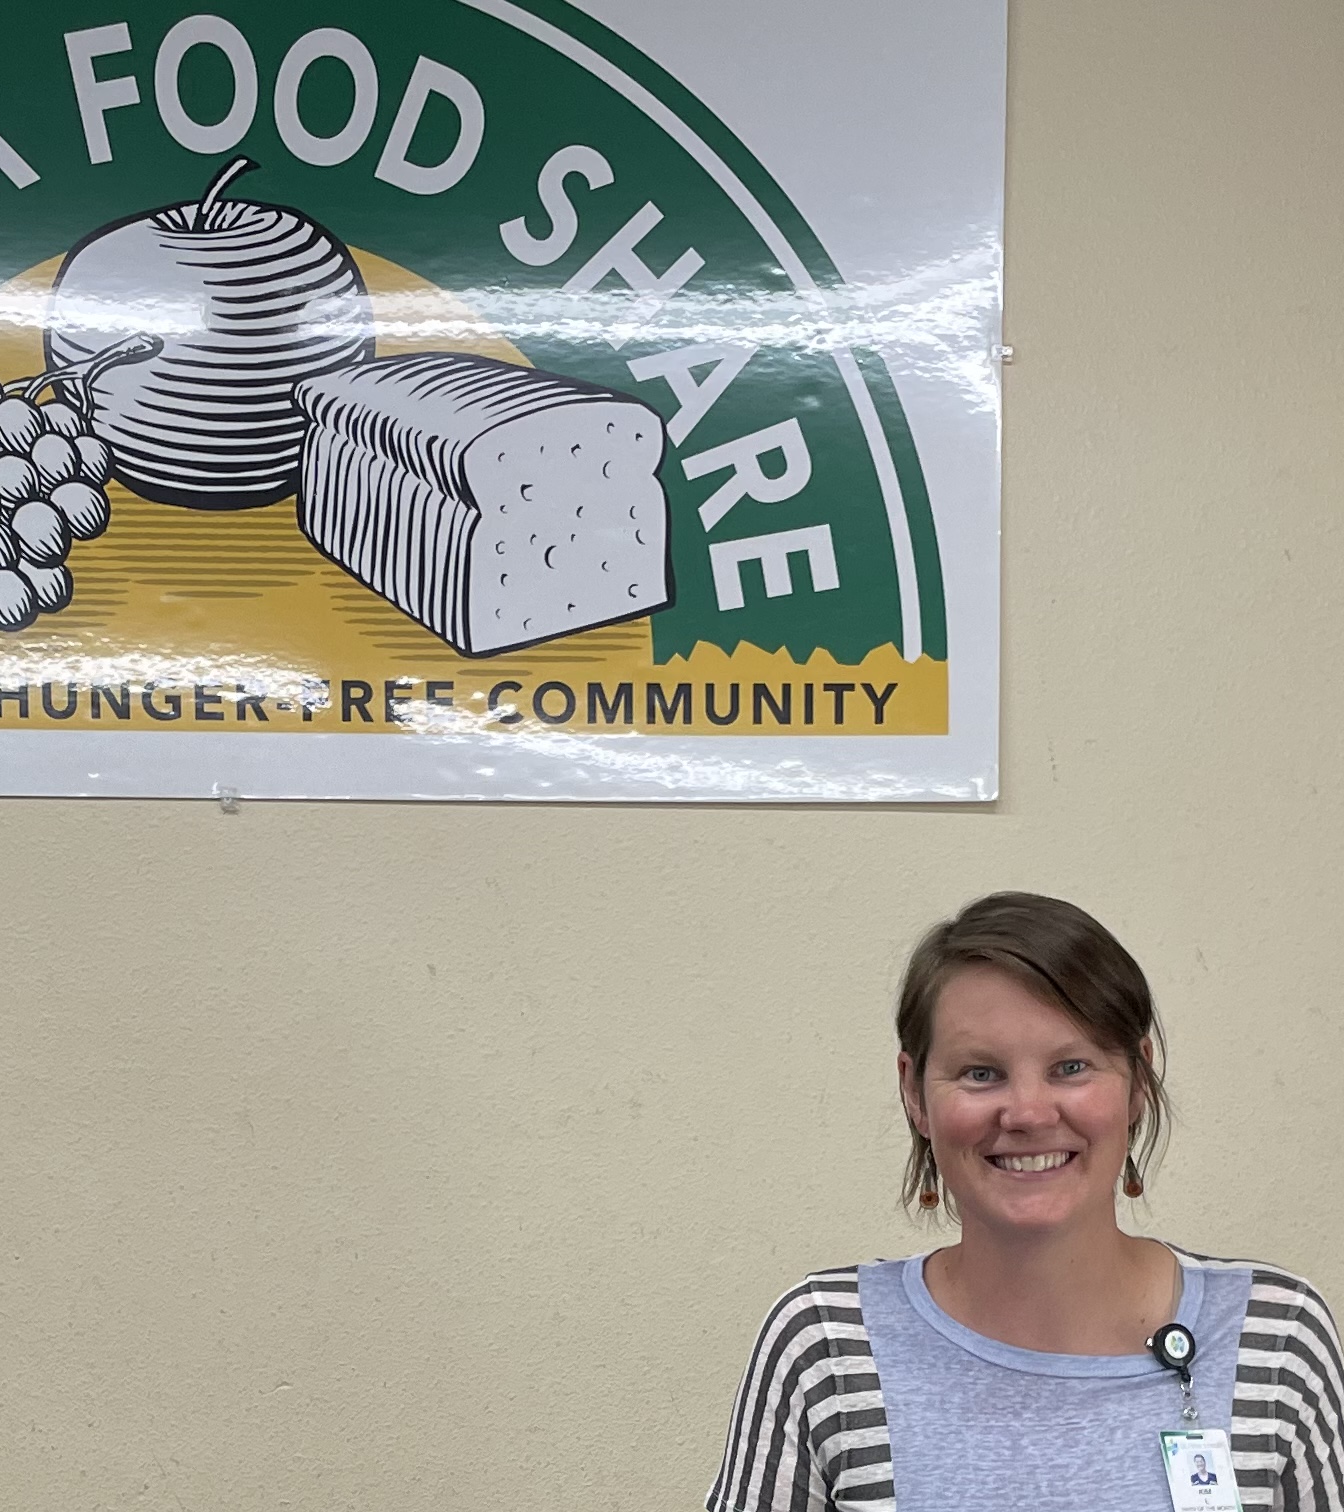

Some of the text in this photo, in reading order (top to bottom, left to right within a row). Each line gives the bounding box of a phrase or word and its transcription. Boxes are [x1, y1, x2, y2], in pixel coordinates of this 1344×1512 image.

[63, 14, 485, 195] FOOD
[499, 144, 840, 612] SHARE
[488, 680, 898, 726] COMMUNITY
